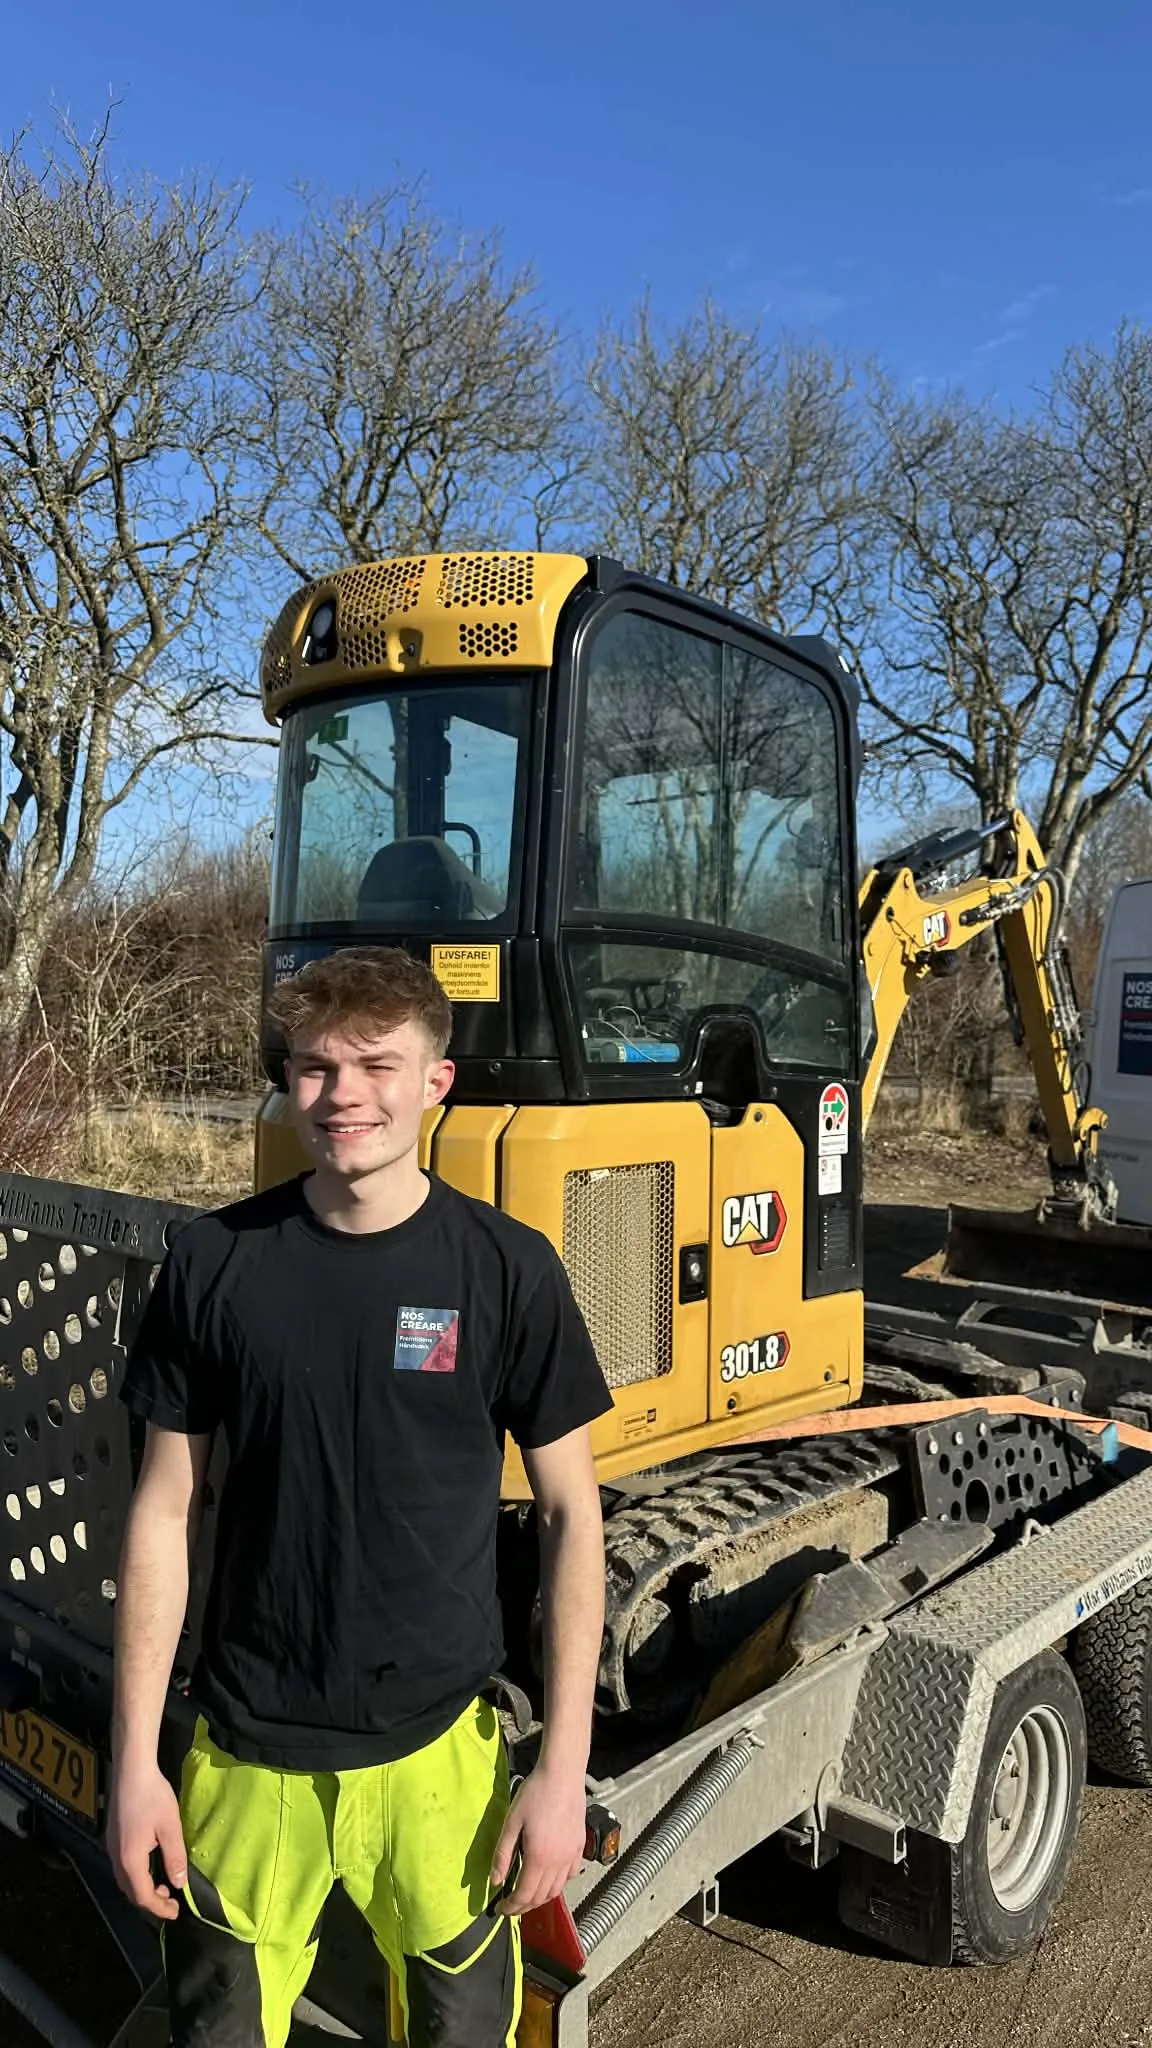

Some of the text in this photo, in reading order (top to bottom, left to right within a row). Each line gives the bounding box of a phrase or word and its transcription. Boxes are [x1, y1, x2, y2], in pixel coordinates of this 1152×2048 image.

[923, 912, 946, 945] CAT
[275, 954, 295, 969] NOS
[439, 950, 491, 960] LIVSFARE!
[1126, 981, 1152, 994] NOS
[1125, 995, 1152, 1008] CRE
[72, 1202, 141, 1247] Trailers
[723, 1192, 773, 1246] CAT
[401, 1311, 424, 1321] NOS
[400, 1320, 444, 1331] CREARE
[722, 1335, 779, 1382] 301.8
